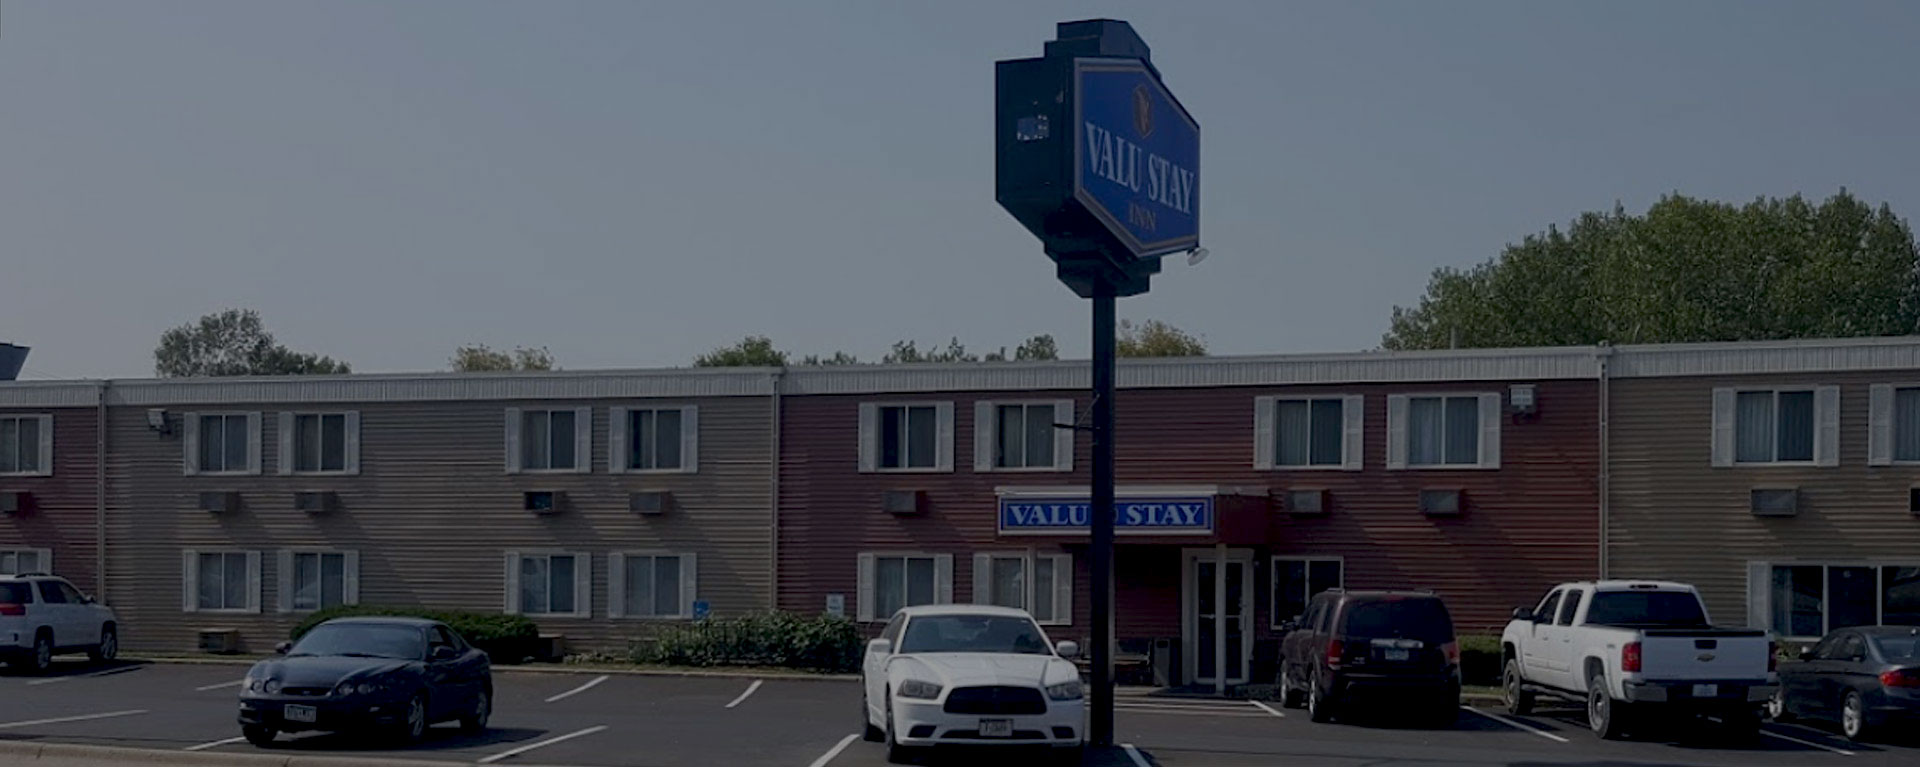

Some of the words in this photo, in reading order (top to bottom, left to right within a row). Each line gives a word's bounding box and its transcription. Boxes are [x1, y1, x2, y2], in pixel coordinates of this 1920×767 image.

[1085, 121, 1142, 193] VALU
[1148, 153, 1194, 215] STAY
[1129, 203, 1156, 232] INN
[1009, 505, 1088, 525] VALU
[1126, 505, 1201, 526] STAY
